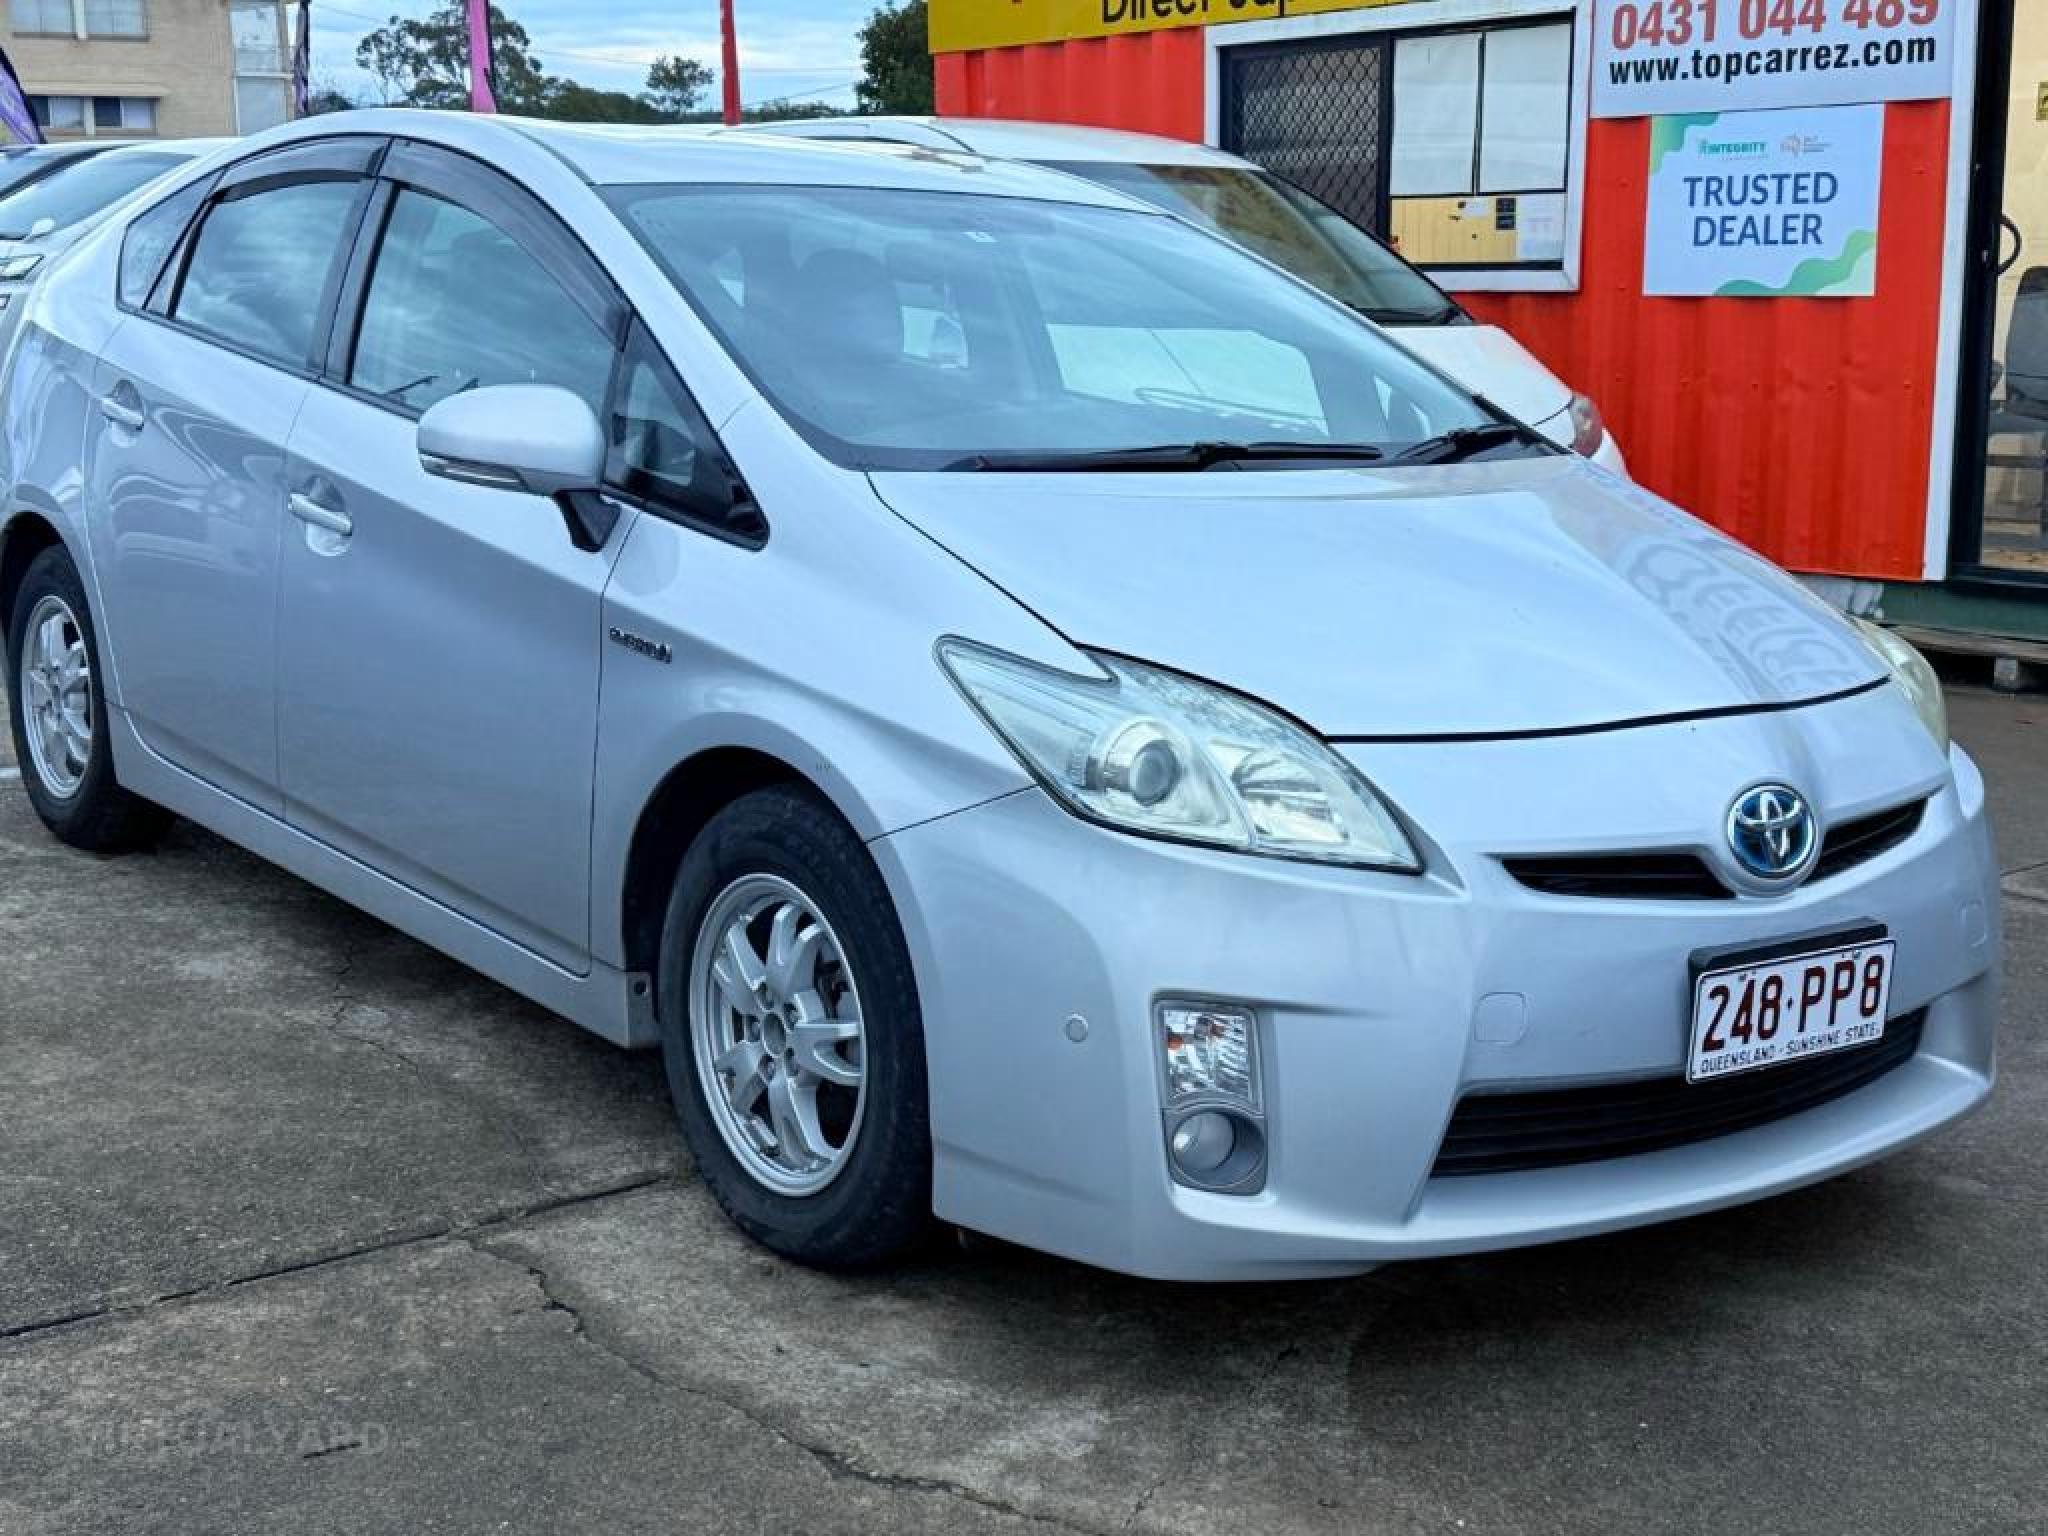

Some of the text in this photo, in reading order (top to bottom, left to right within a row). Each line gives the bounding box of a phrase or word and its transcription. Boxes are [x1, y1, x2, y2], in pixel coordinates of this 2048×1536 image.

[1611, 0, 1716, 50] 0431
[1737, 0, 1827, 40] 044
[1609, 35, 1936, 84] www.topcarrez.com
[1684, 171, 1839, 208] TRUSTED
[1693, 213, 1824, 247] DEALER
[1786, 1029, 1841, 1055] SUNSHINE
[1846, 1021, 1877, 1043] STATE
